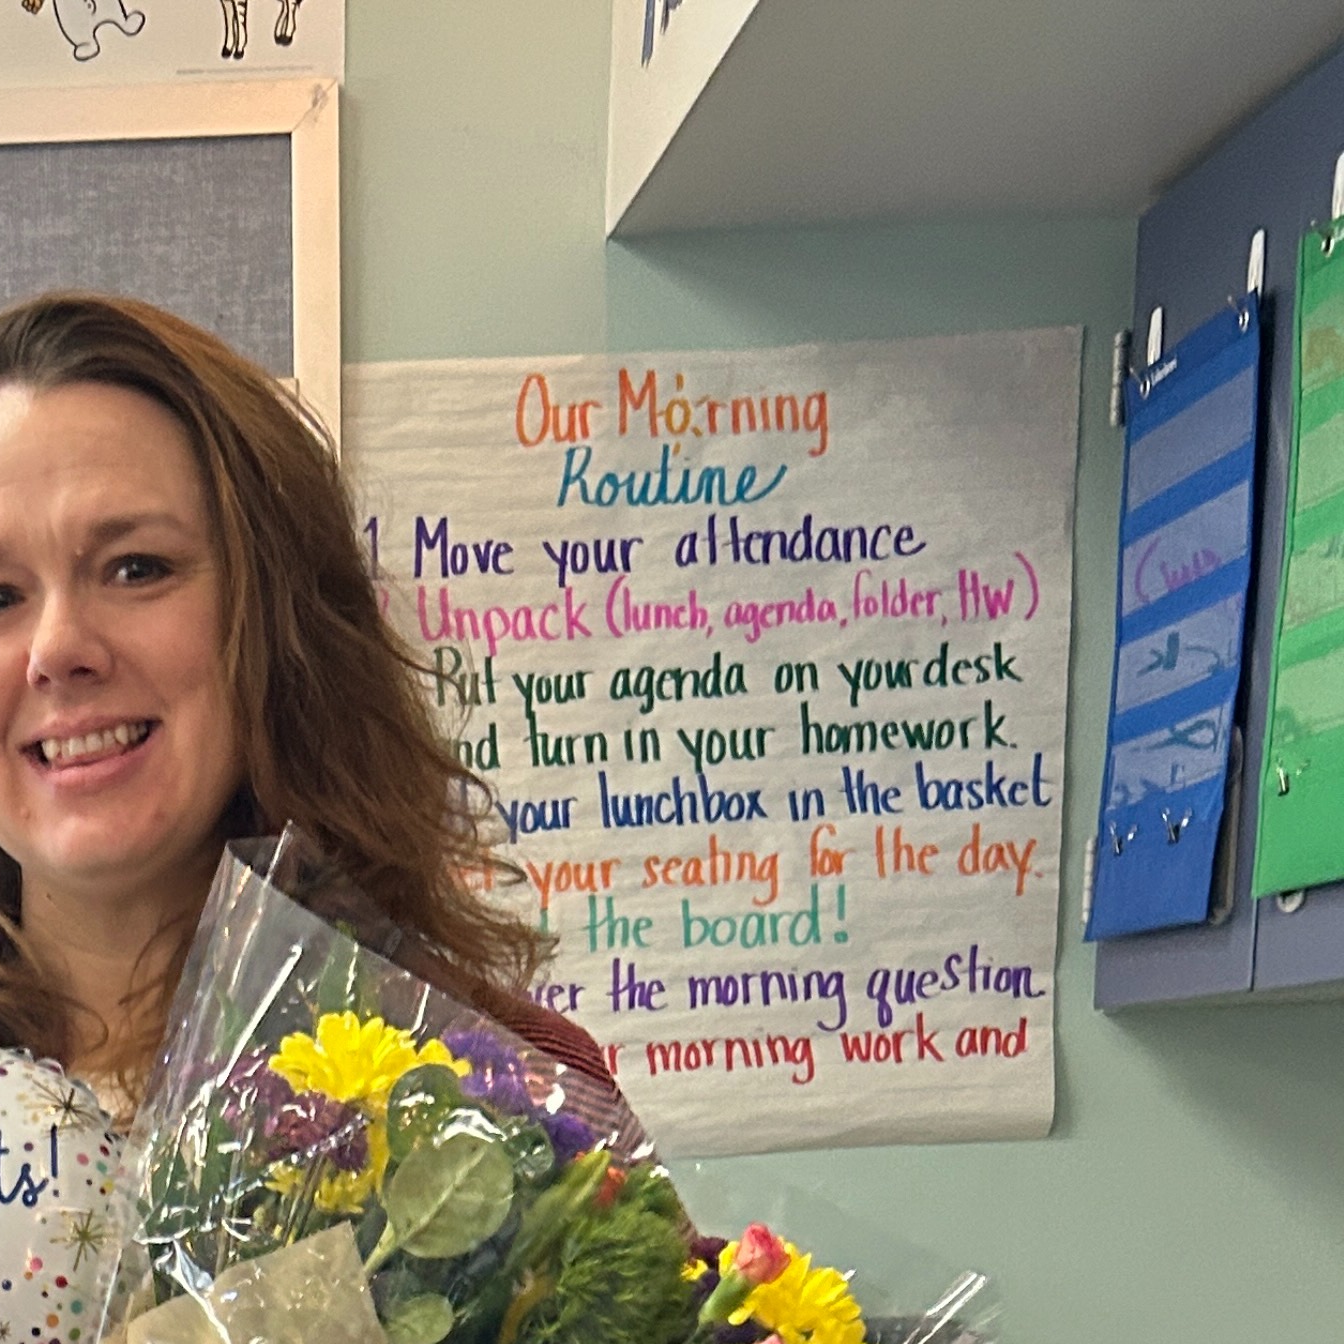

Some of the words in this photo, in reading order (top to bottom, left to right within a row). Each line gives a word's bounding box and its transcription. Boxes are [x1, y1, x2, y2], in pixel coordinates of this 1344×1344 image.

[517, 374, 601, 446] Our
[618, 368, 827, 456] Morning
[557, 445, 787, 508] Routine
[414, 518, 514, 578] Move
[547, 534, 644, 588] your
[676, 515, 926, 568] attendance
[417, 585, 591, 656] Unpack
[607, 575, 714, 639] (lunch,
[724, 594, 847, 642] agenda,
[854, 569, 947, 628] folder,
[433, 648, 501, 706] Put
[512, 670, 594, 717] your
[610, 652, 746, 714] agenda
[775, 658, 818, 691] on
[837, 658, 911, 710] your
[920, 642, 1022, 685] desk
[447, 718, 500, 771] nd
[528, 705, 607, 766] turn
[625, 724, 660, 760] in
[677, 724, 774, 773] your
[802, 702, 1018, 758] homework.
[495, 796, 578, 842] your
[600, 772, 767, 828] lunchbox
[788, 786, 826, 821] in
[841, 765, 901, 814] the
[915, 754, 1052, 806] basket
[528, 850, 620, 909] your
[642, 835, 778, 906] seating
[810, 824, 847, 876] for
[875, 825, 938, 878] the
[956, 825, 1045, 896] day.
[581, 896, 654, 952] the
[682, 885, 848, 948] board!
[606, 958, 668, 1011] the
[688, 970, 845, 1031] morning
[646, 1032, 814, 1084] morning
[841, 1012, 945, 1062] work
[955, 1018, 1028, 1059] and
